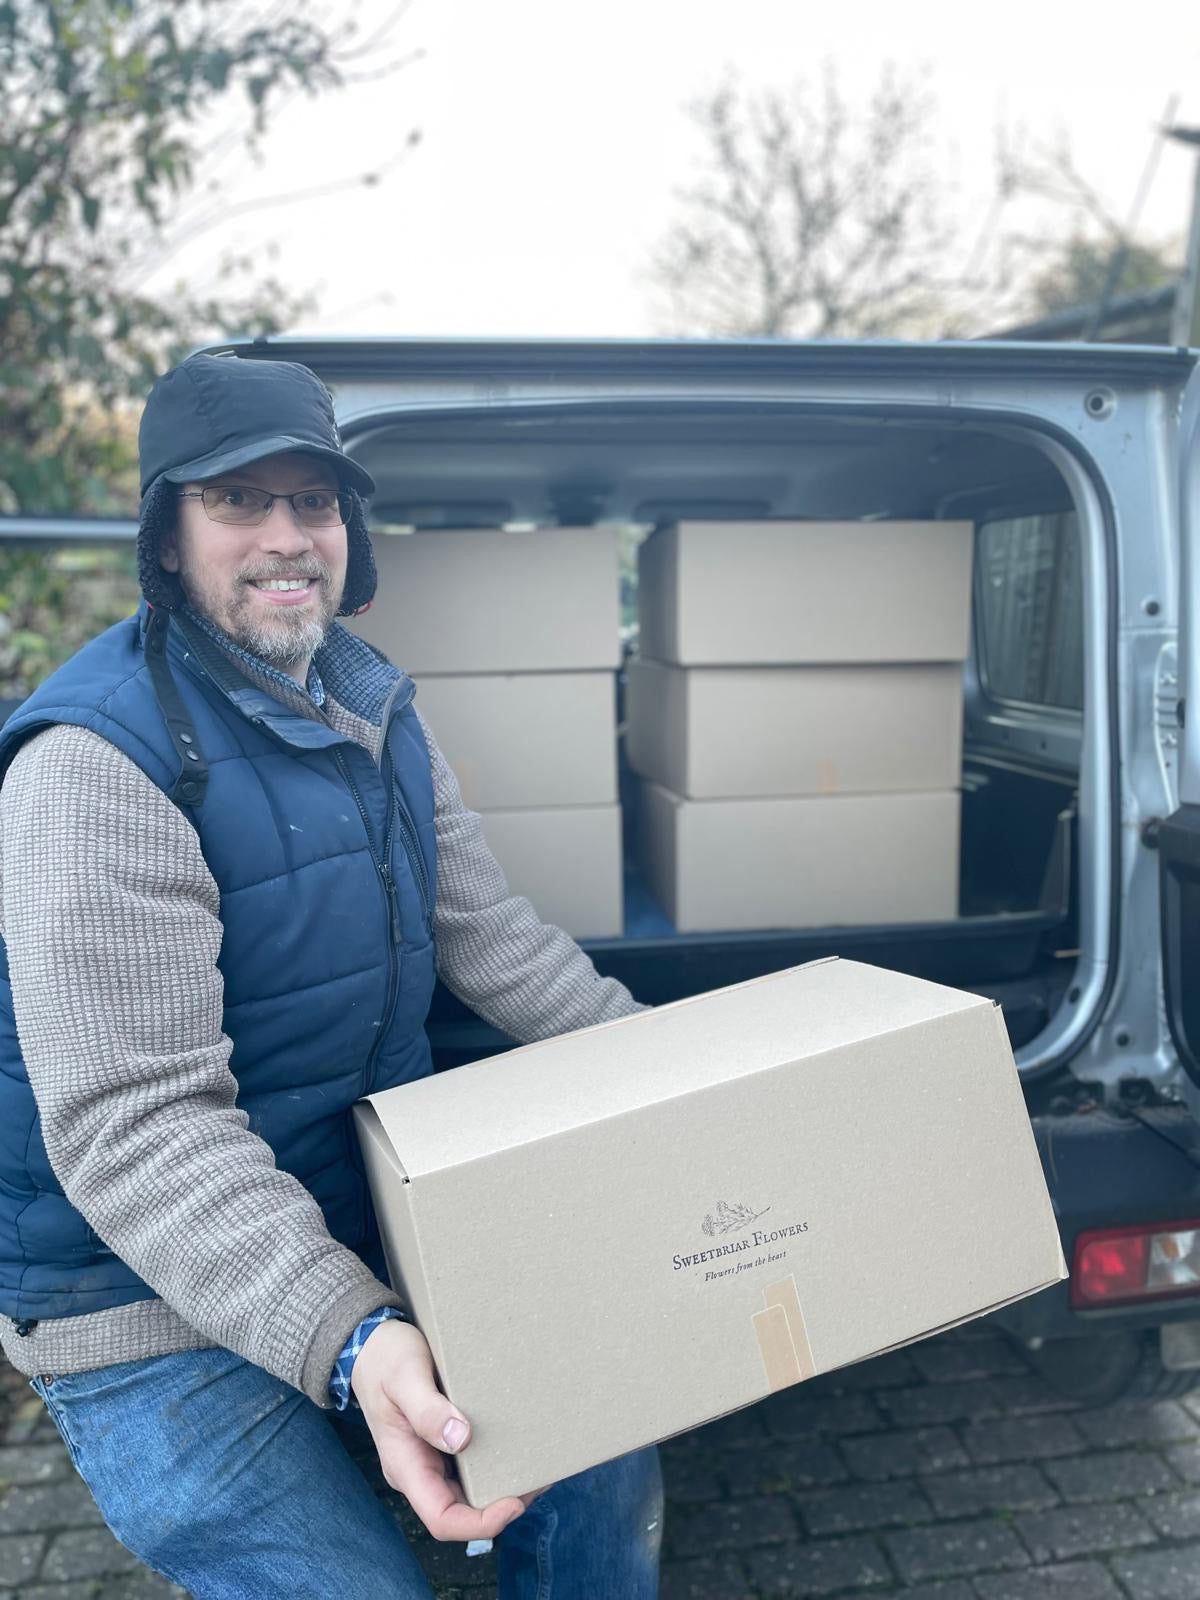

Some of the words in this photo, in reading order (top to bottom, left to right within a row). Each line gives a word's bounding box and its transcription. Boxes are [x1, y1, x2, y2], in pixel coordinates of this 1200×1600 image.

[672, 1239, 751, 1271] SWEETBRIAR
[752, 1221, 809, 1247] FLOWERS
[705, 1267, 735, 1282] Flowers
[735, 1262, 753, 1275] from
[754, 1256, 766, 1267] the
[767, 1251, 787, 1263] heart
